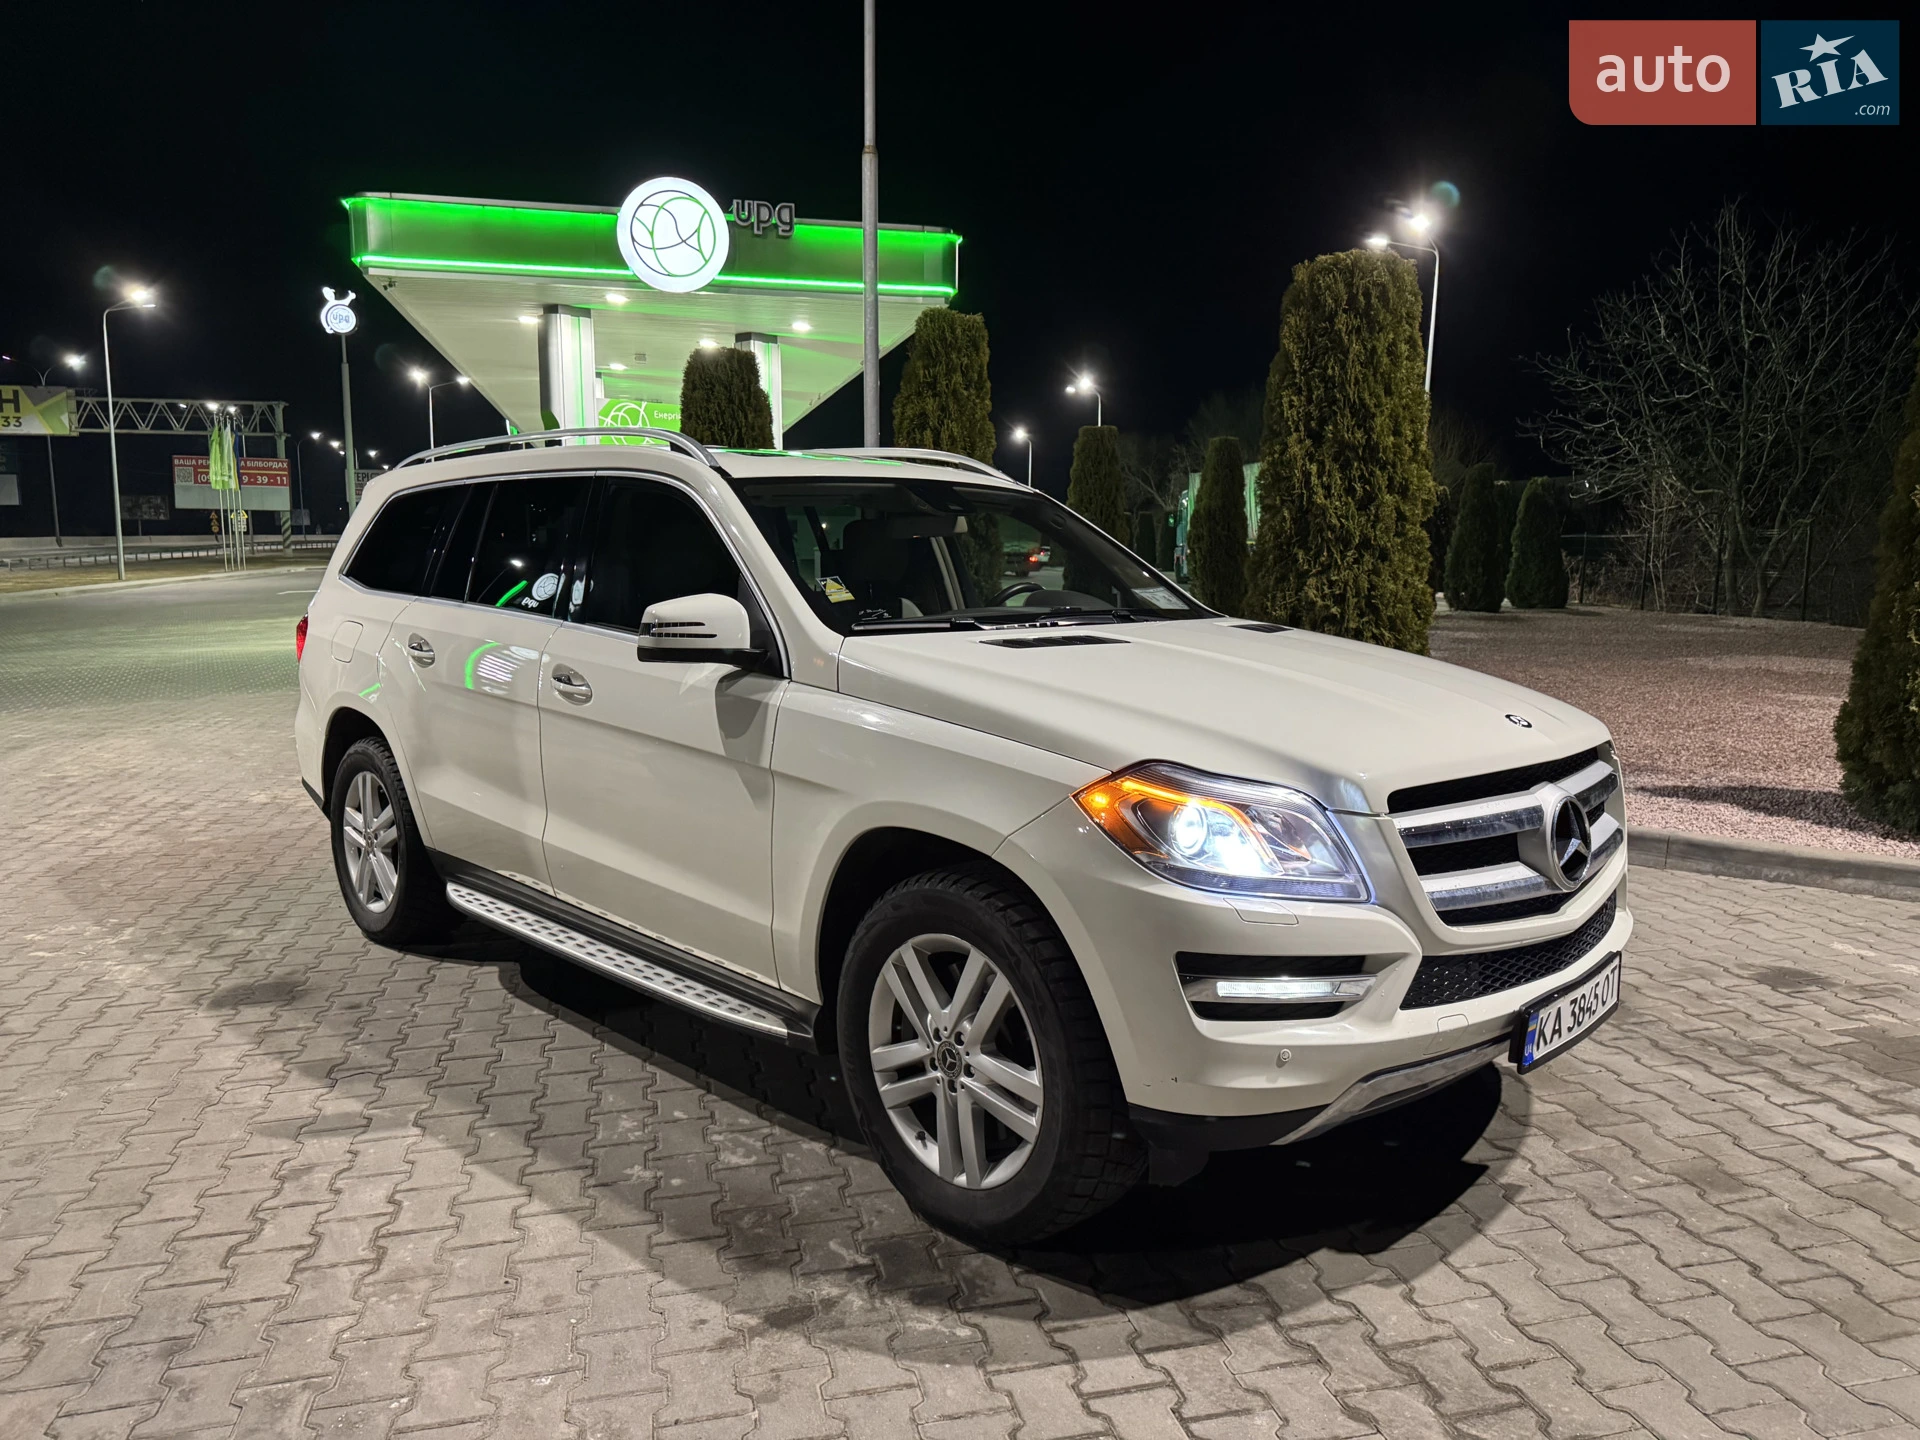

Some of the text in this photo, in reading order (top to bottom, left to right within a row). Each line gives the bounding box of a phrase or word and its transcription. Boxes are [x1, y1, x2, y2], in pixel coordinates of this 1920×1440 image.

[733, 199, 795, 235] upg
[332, 312, 350, 324] upg
[247, 461, 288, 469] БІЛБОРДАХ
[1536, 965, 1617, 1051] KA 3845 OT
